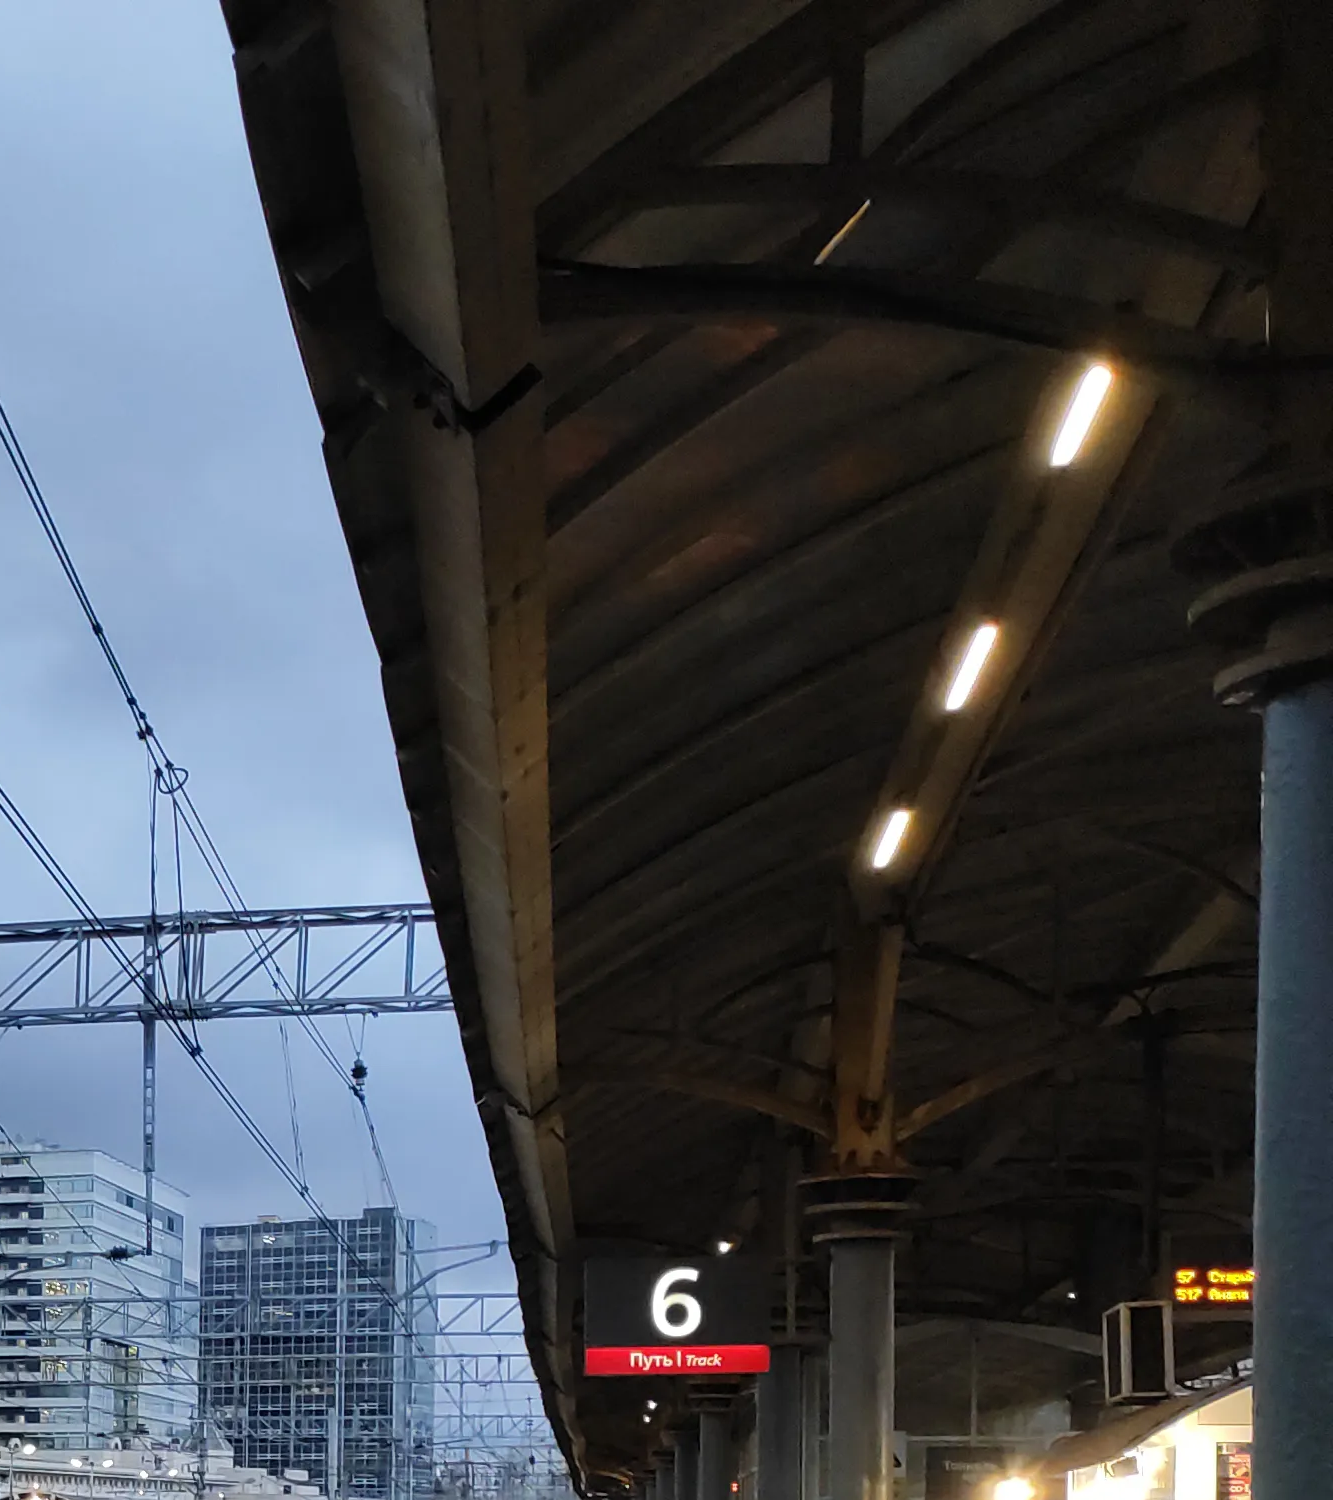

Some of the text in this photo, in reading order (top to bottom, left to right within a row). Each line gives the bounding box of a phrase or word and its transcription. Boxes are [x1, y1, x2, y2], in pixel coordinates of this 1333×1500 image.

[652, 1266, 702, 1338] 6
[629, 1352, 674, 1371] Путь
[685, 1353, 723, 1368] Track
